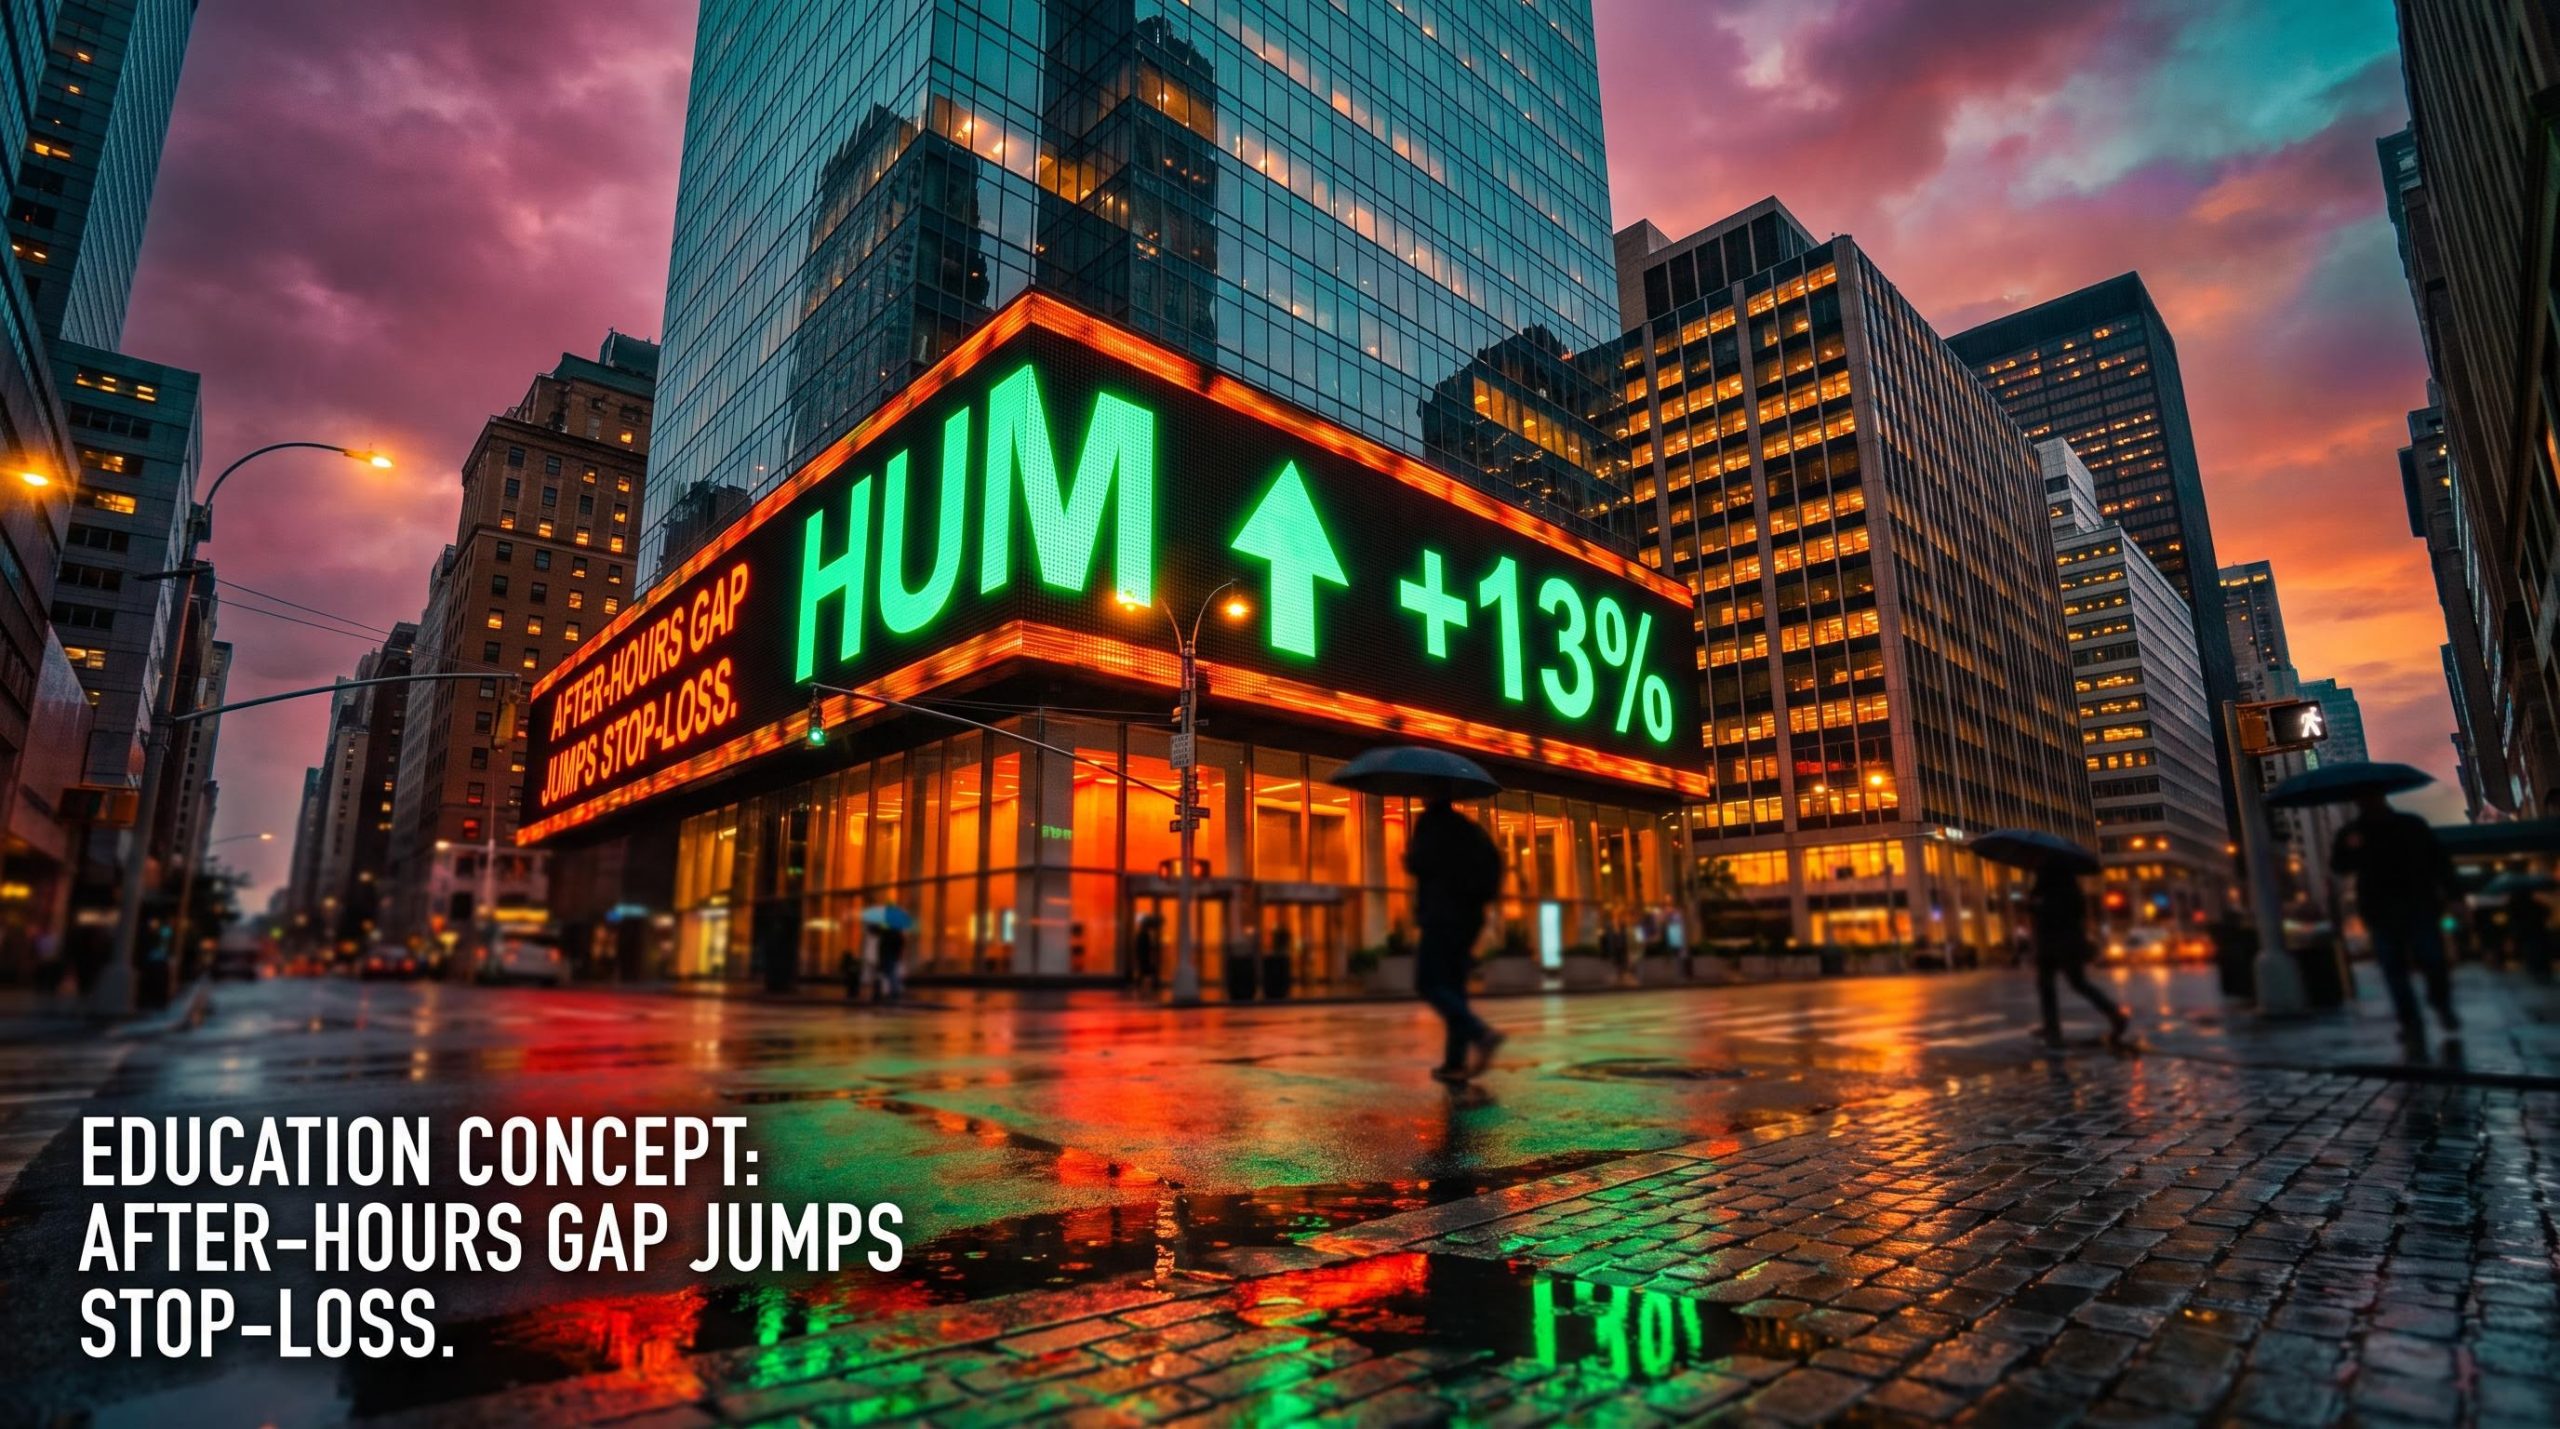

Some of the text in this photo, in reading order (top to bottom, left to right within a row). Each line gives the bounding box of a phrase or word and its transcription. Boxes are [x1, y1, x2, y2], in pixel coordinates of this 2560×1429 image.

[795, 364, 1673, 743] HUM +13%
[541, 657, 738, 807] JUMPS STOP-LOSS.
[550, 563, 748, 742] AFTER-HOURS GAP
